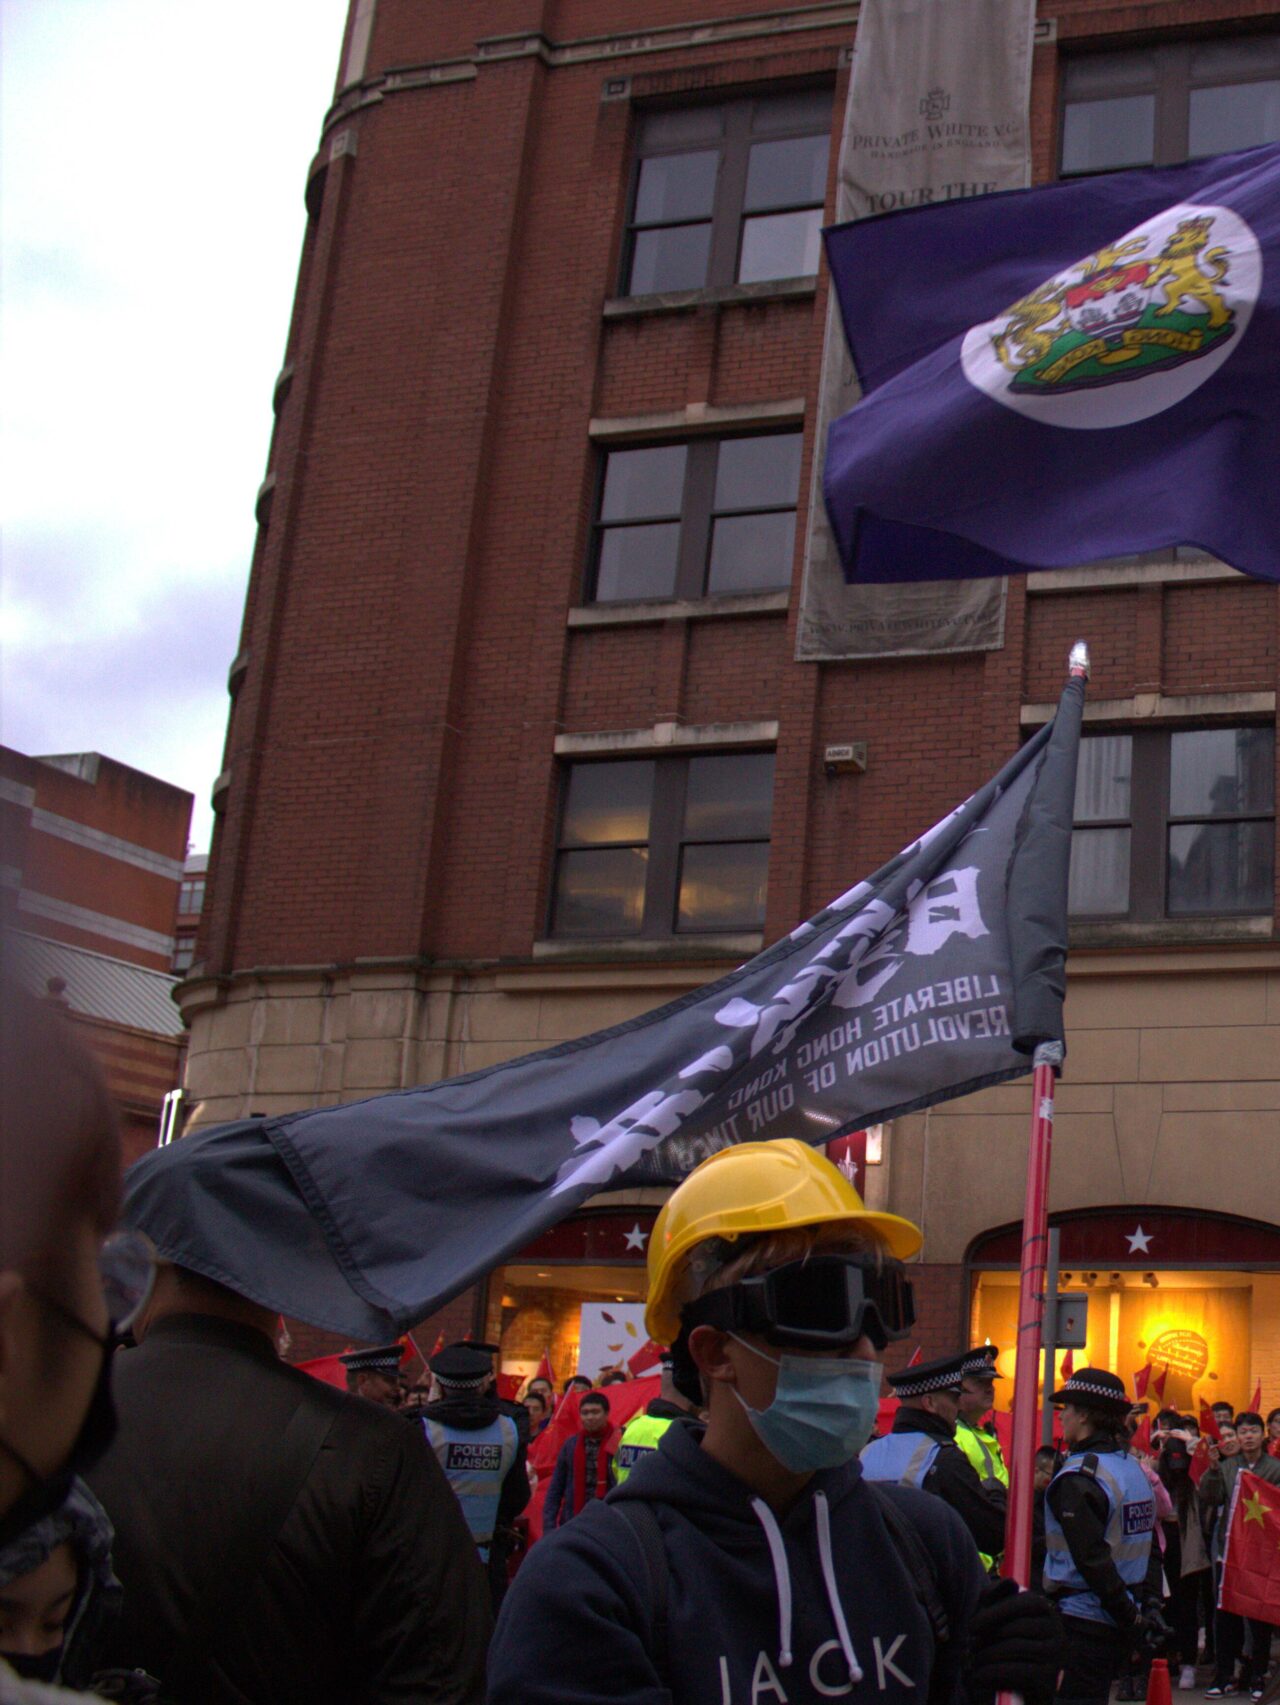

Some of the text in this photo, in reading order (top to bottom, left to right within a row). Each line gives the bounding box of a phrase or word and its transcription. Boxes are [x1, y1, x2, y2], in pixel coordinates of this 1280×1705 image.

[853, 129, 919, 150] PRIVATE
[927, 123, 988, 139] WHITE
[865, 182, 998, 213] TOUR THE
[453, 1444, 499, 1457] POLICE
[449, 1456, 500, 1469] LIAISON
